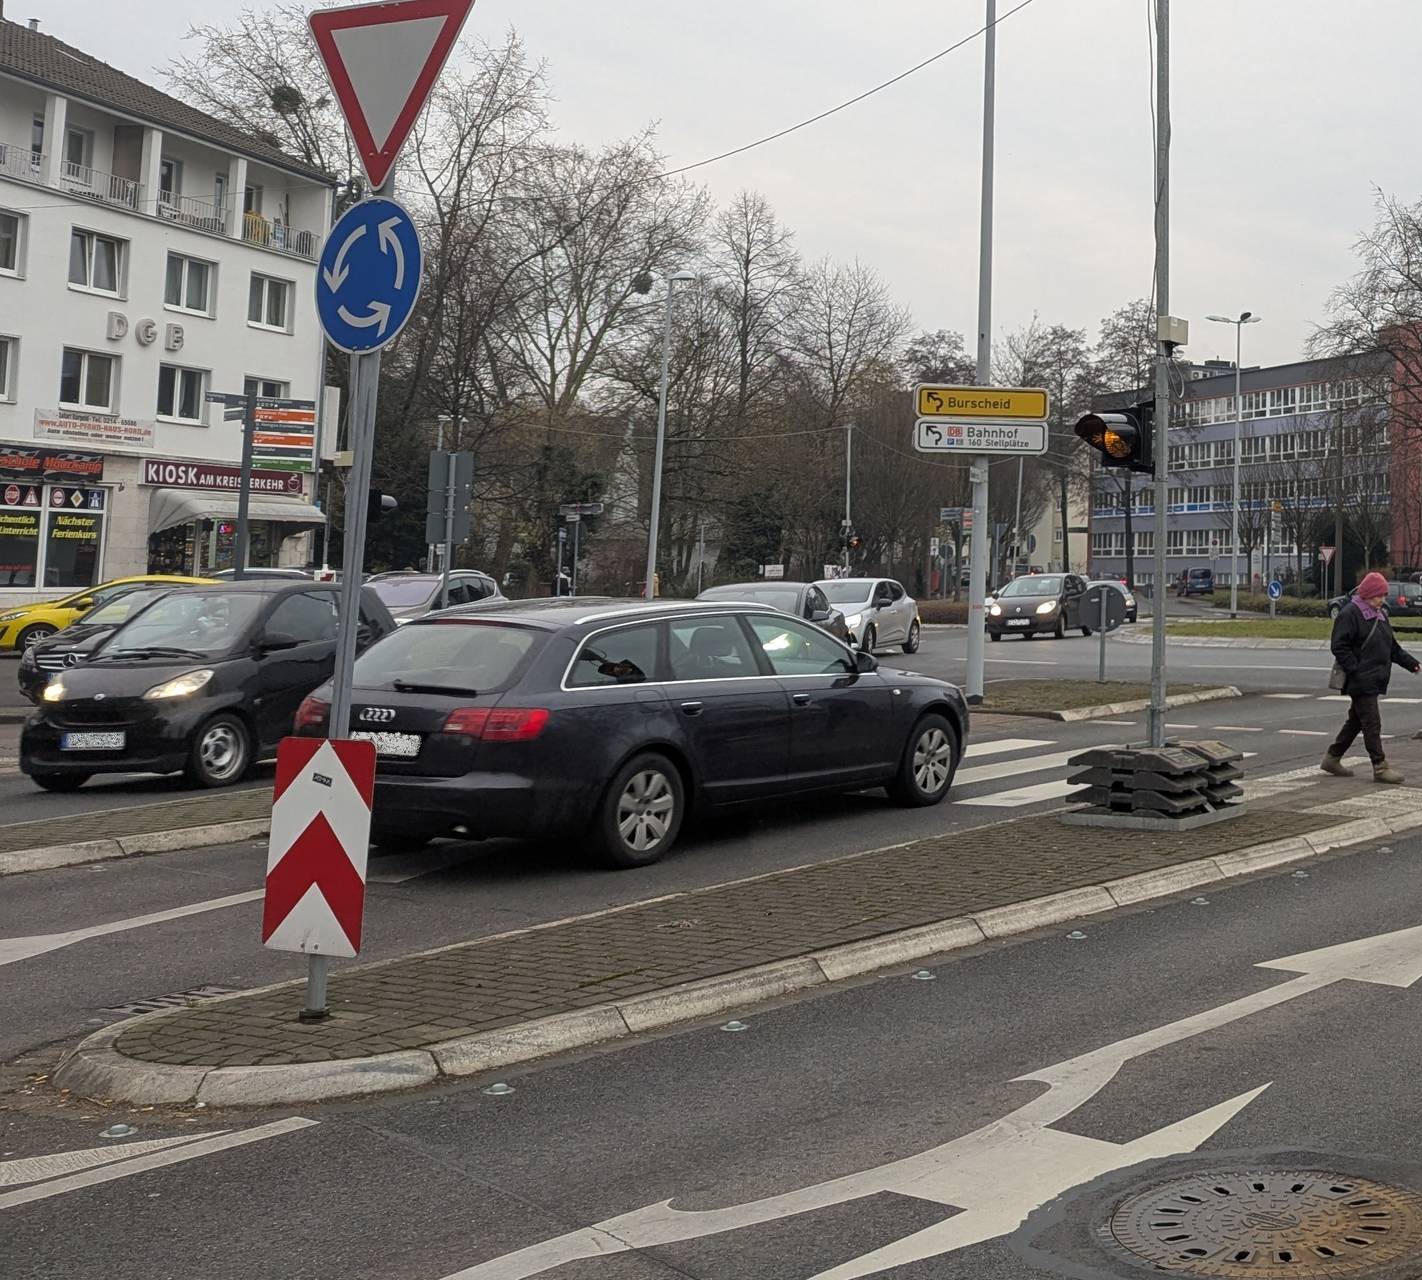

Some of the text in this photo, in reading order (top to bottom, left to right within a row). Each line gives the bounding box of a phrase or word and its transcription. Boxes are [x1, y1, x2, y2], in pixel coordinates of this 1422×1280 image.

[106, 312, 184, 351] DGB
[948, 397, 1011, 409] Burscheid
[967, 427, 1019, 439] Bahnhof
[985, 439, 1030, 448] Stellplätze
[147, 463, 284, 490] KIOSK AM KREISERKEHR
[56, 516, 96, 527] Nächster
[51, 528, 97, 539] Ferienkurs
